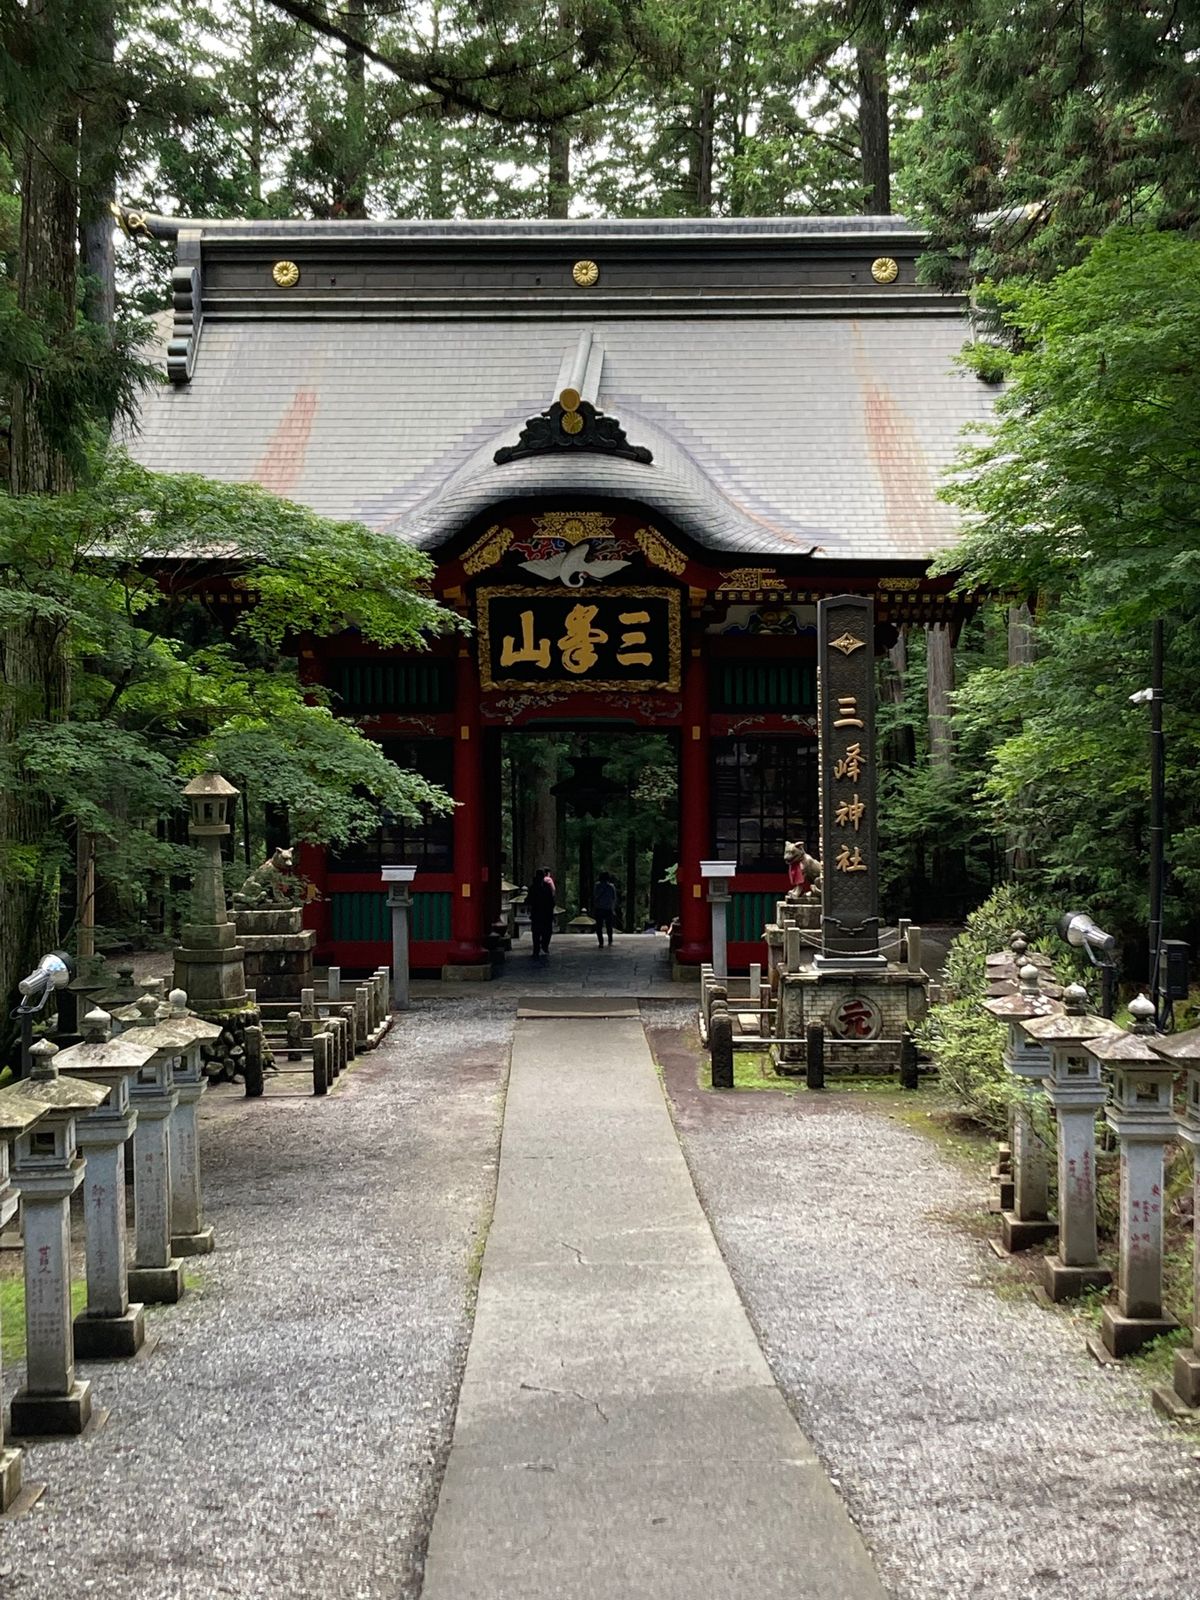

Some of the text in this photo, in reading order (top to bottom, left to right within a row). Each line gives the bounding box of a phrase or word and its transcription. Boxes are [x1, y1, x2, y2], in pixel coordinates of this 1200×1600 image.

[833, 696, 867, 873] 三峰神社
[839, 1001, 872, 1036] 元
